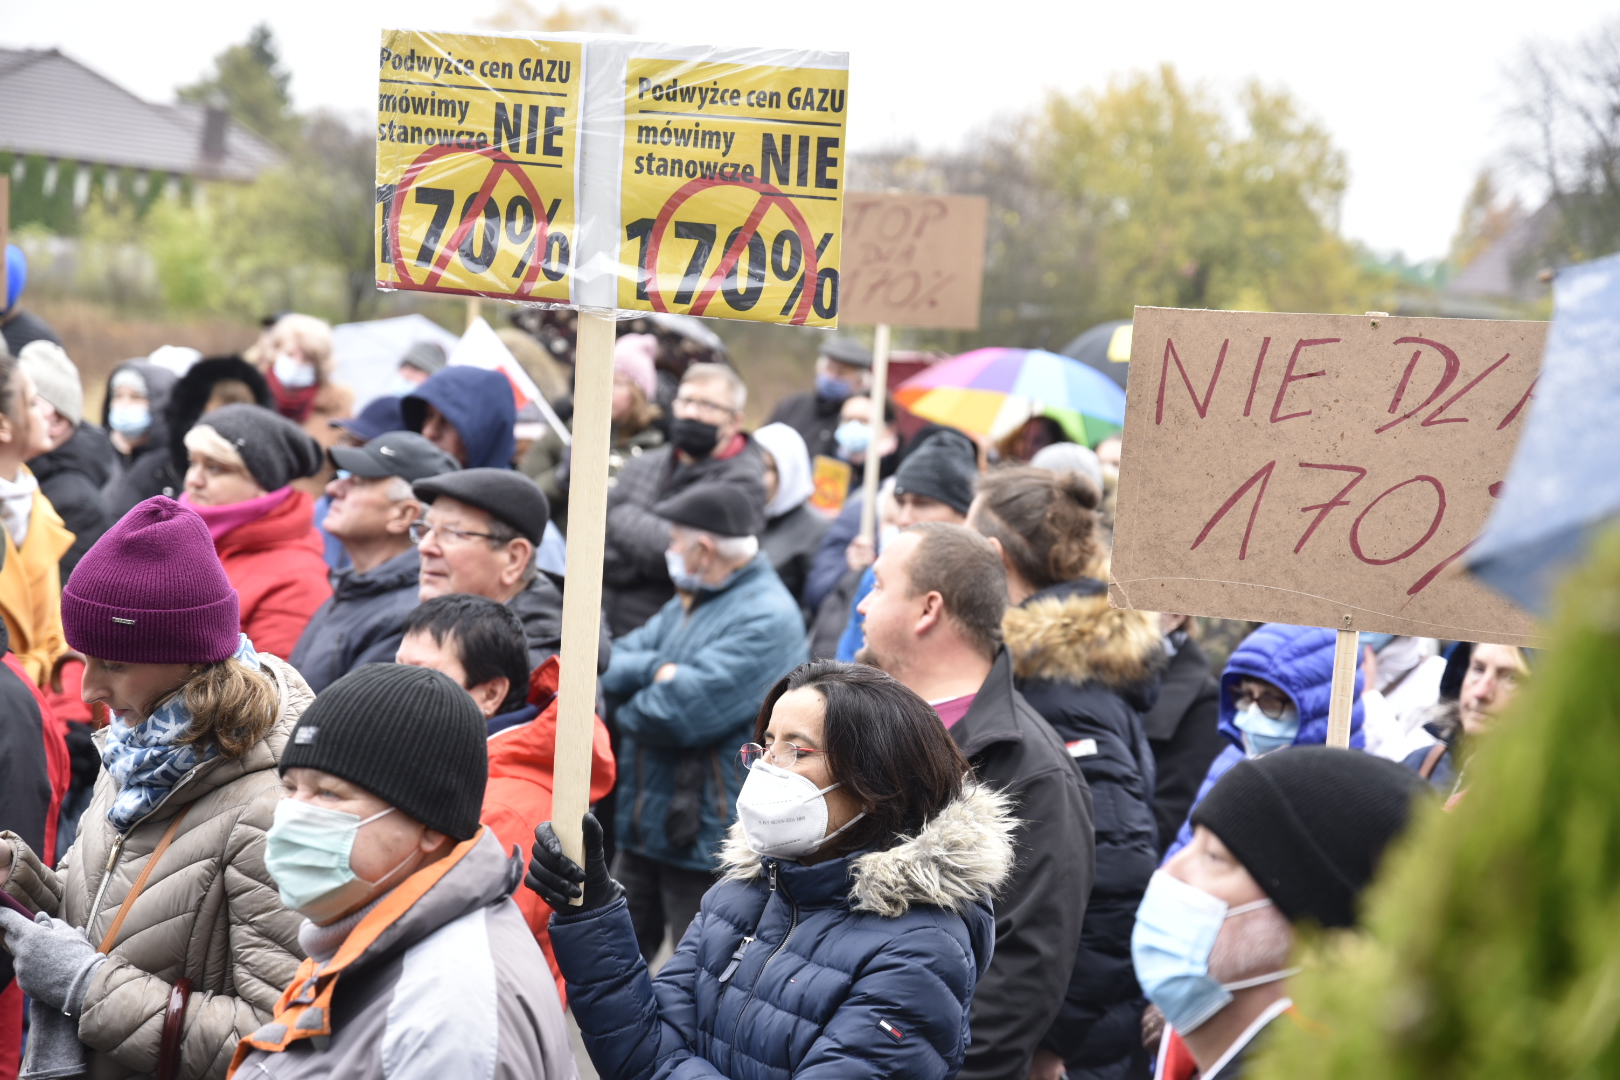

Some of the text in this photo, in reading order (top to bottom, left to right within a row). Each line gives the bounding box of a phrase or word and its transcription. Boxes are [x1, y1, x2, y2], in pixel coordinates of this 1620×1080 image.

[380, 47, 571, 84] Podwyżce cen GAZU
[379, 88, 470, 125] mówimy
[639, 77, 844, 113] Podwyżce cen GAZU
[378, 102, 565, 157] stanowcze NIE
[637, 120, 736, 158] mówimy
[634, 133, 839, 189] stanowcze NIE
[377, 183, 570, 282] 170%
[842, 199, 948, 242] TOP
[625, 217, 840, 320] 170%
[1155, 336, 1342, 425] NIE
